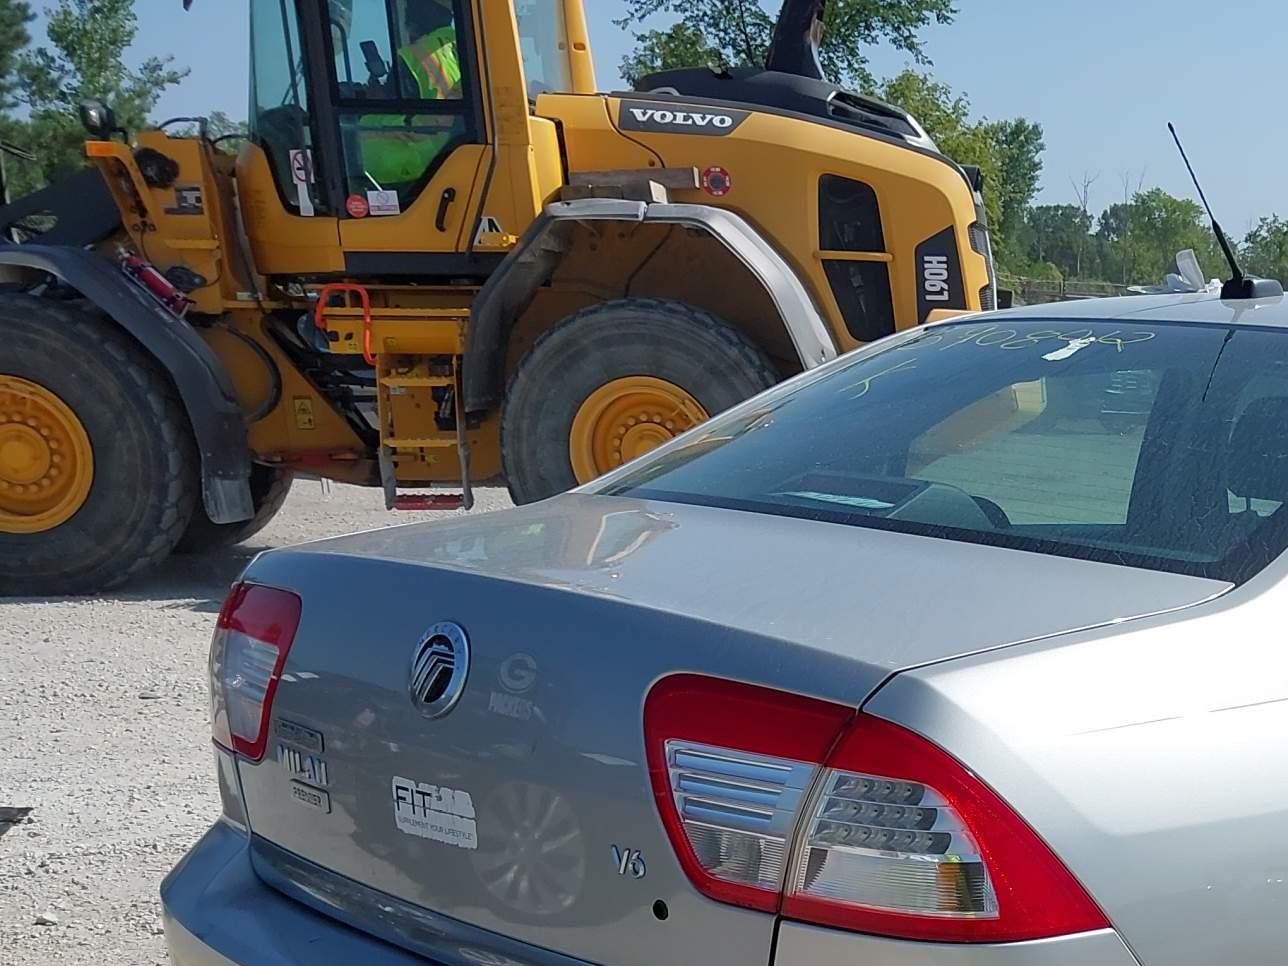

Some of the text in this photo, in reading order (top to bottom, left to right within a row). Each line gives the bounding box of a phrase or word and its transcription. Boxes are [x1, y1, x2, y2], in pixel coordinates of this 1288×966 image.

[629, 107, 733, 128] VOLVO
[923, 255, 950, 301] L90H
[277, 743, 329, 786] MILAN
[395, 784, 432, 818] FIT
[611, 844, 646, 879] V6
